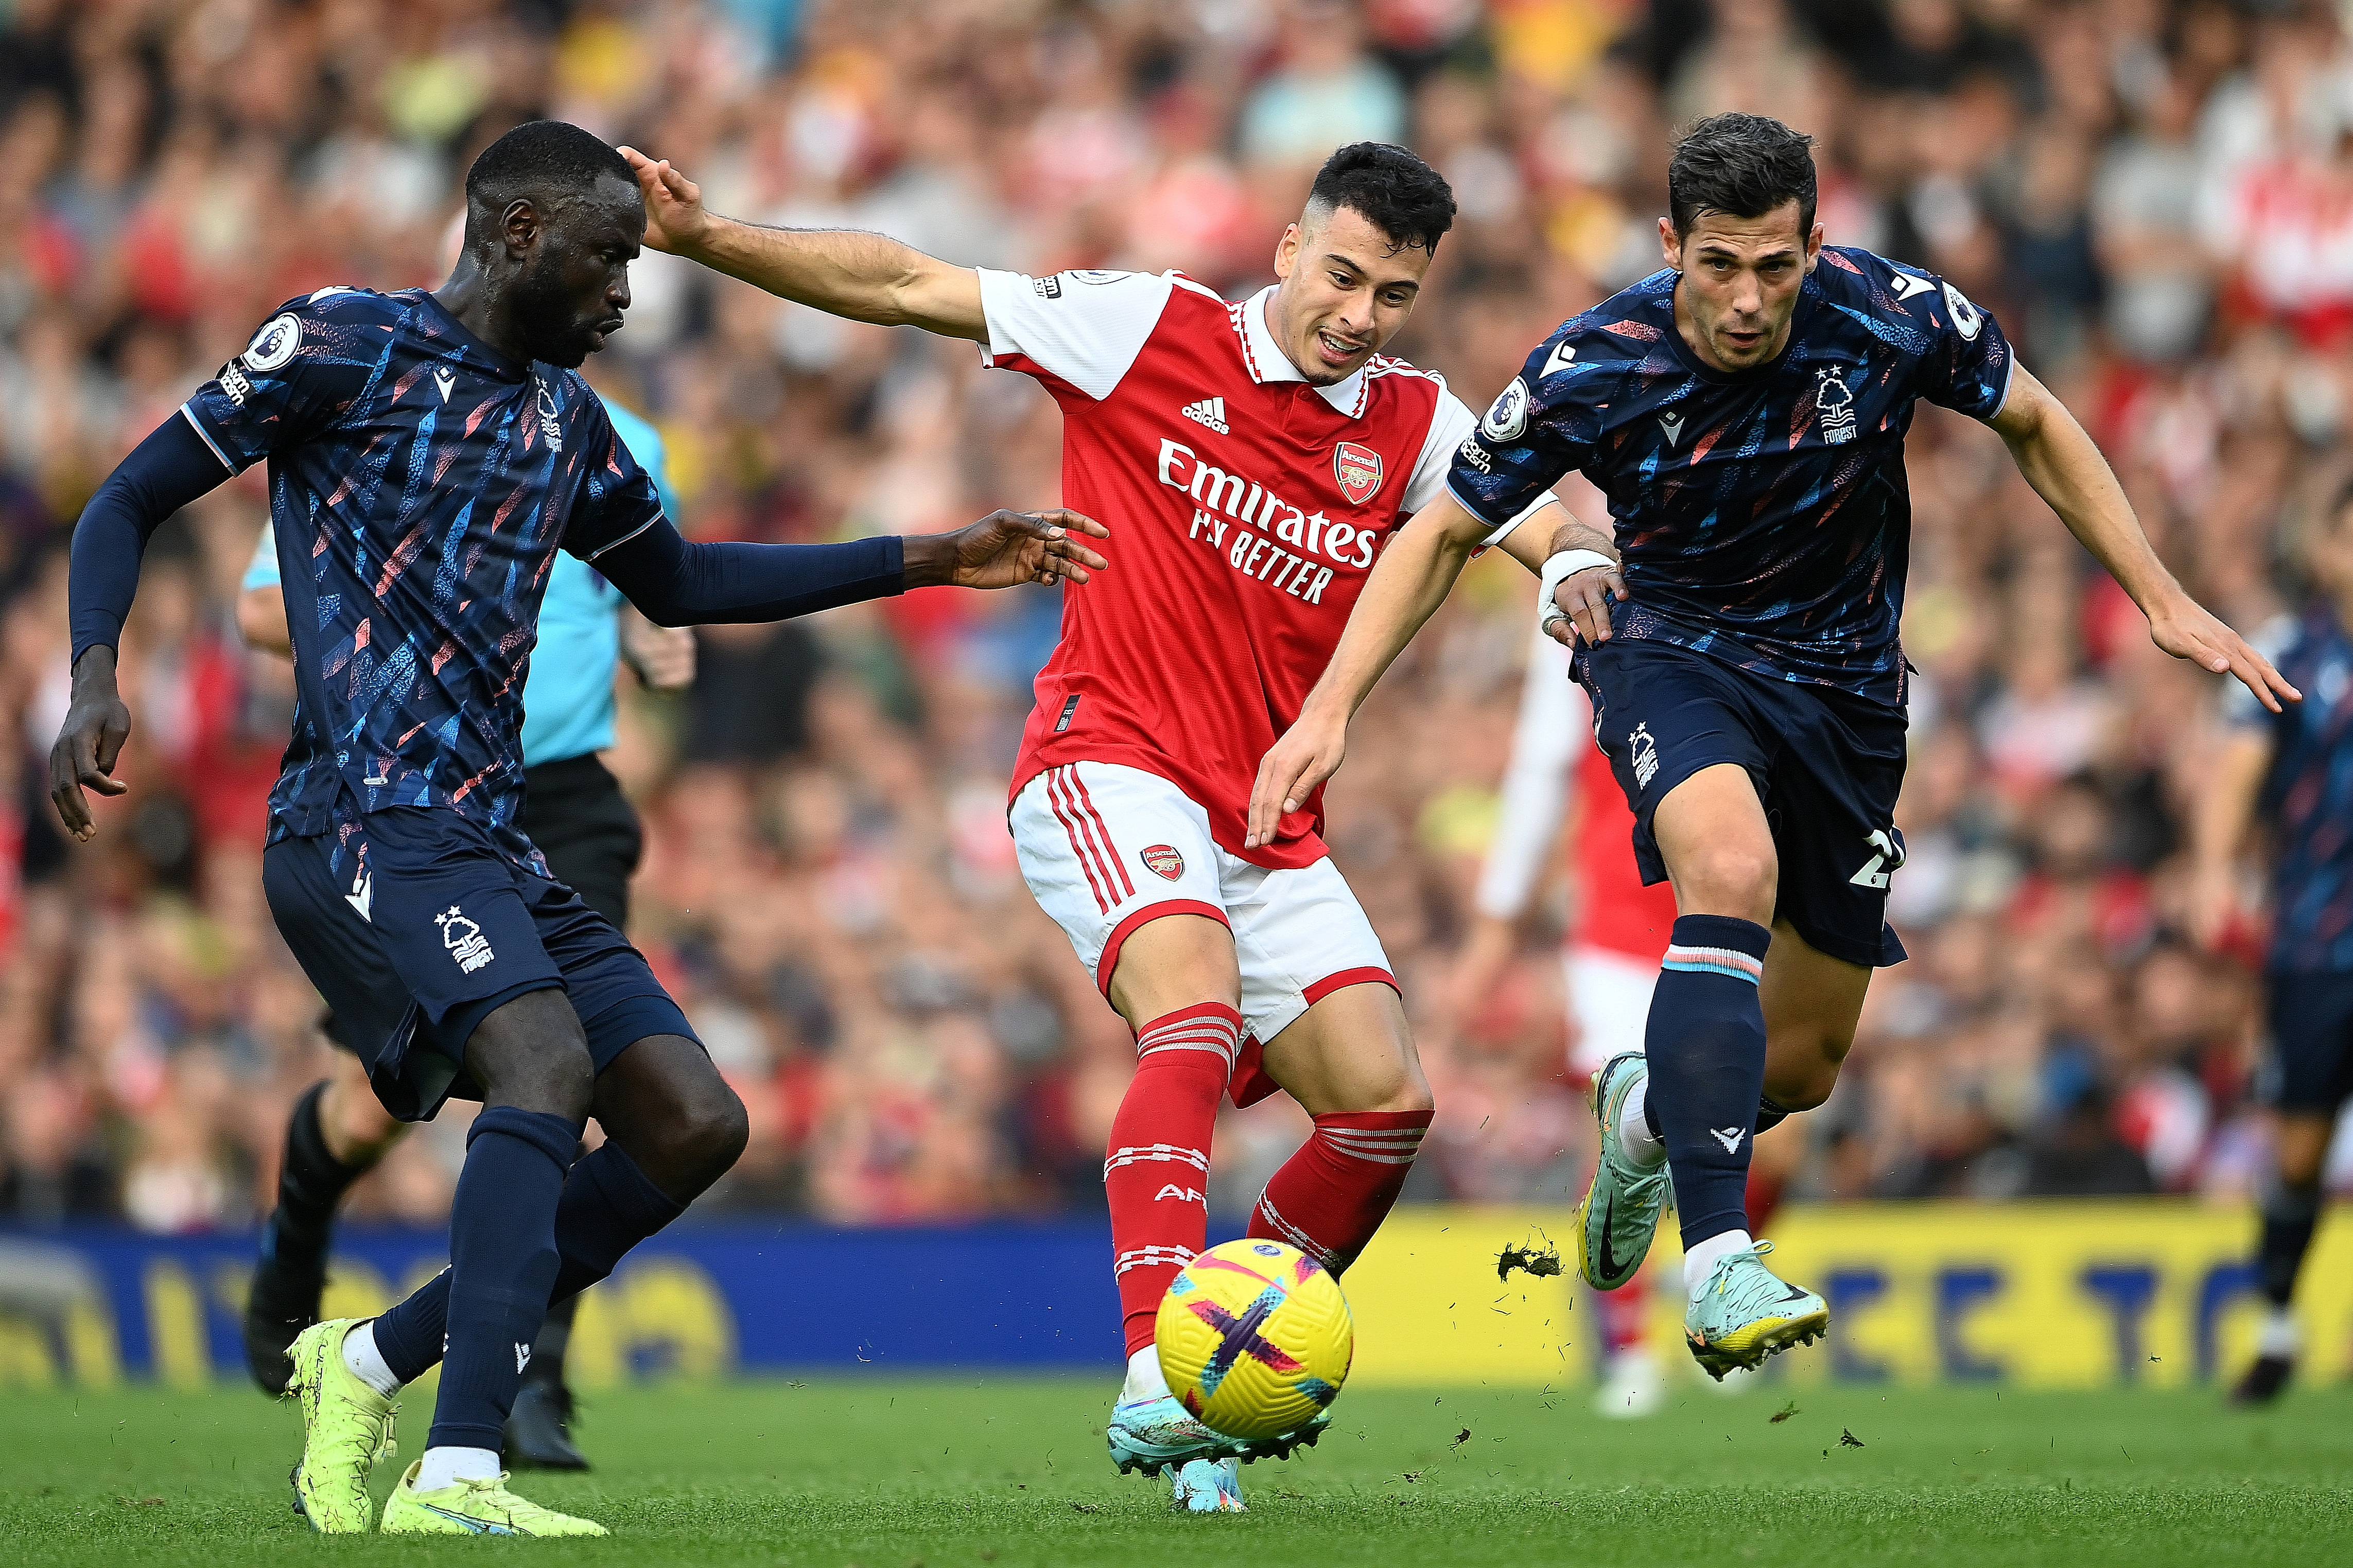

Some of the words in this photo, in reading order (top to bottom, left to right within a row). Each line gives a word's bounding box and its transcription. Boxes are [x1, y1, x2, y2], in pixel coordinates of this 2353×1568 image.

[1181, 406, 1230, 435] adidas
[1342, 450, 1376, 468] Arsenal
[1158, 438, 1375, 568] Emirates
[1230, 531, 1333, 604] BETTER
